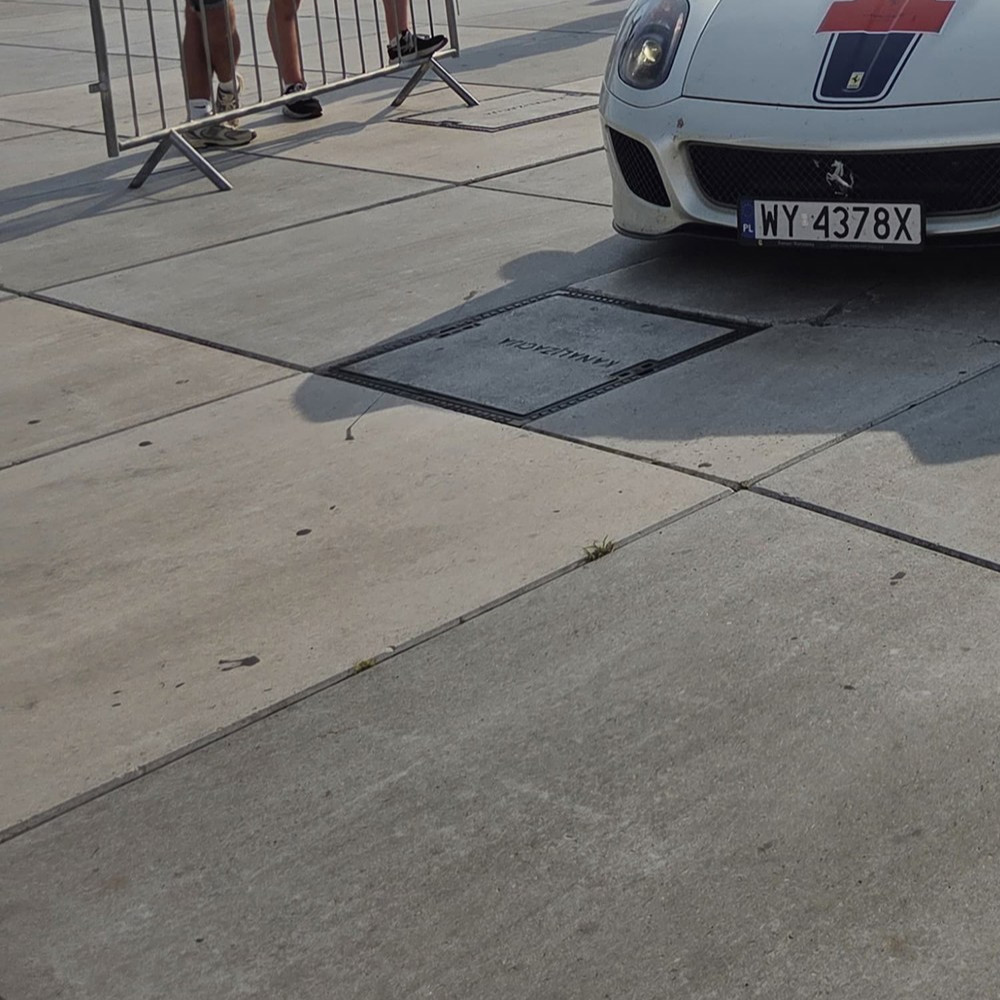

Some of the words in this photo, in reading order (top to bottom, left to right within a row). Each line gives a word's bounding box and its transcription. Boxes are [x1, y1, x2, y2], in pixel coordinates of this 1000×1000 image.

[743, 223, 754, 233] PL
[760, 203, 799, 238] WY
[812, 205, 913, 241] 4378X
